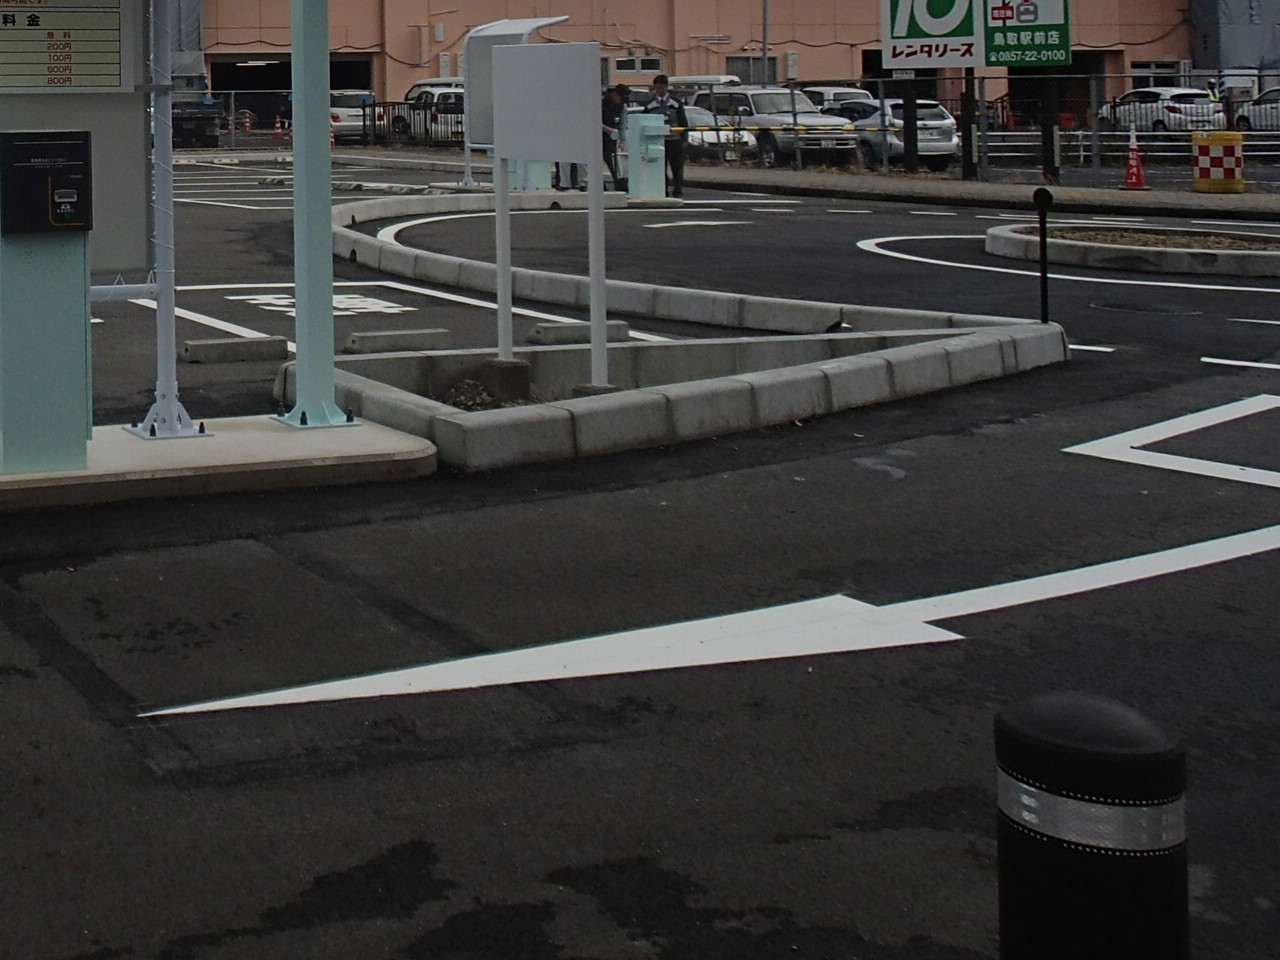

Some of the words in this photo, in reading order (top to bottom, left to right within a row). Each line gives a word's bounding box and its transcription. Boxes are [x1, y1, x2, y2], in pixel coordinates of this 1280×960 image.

[994, 31, 1060, 46] 鳥取駅前店
[46, 42, 72, 51] 200円
[892, 43, 974, 59] レンタリース
[46, 54, 72, 63] 100円
[998, 50, 1066, 62] 0857-22-0100
